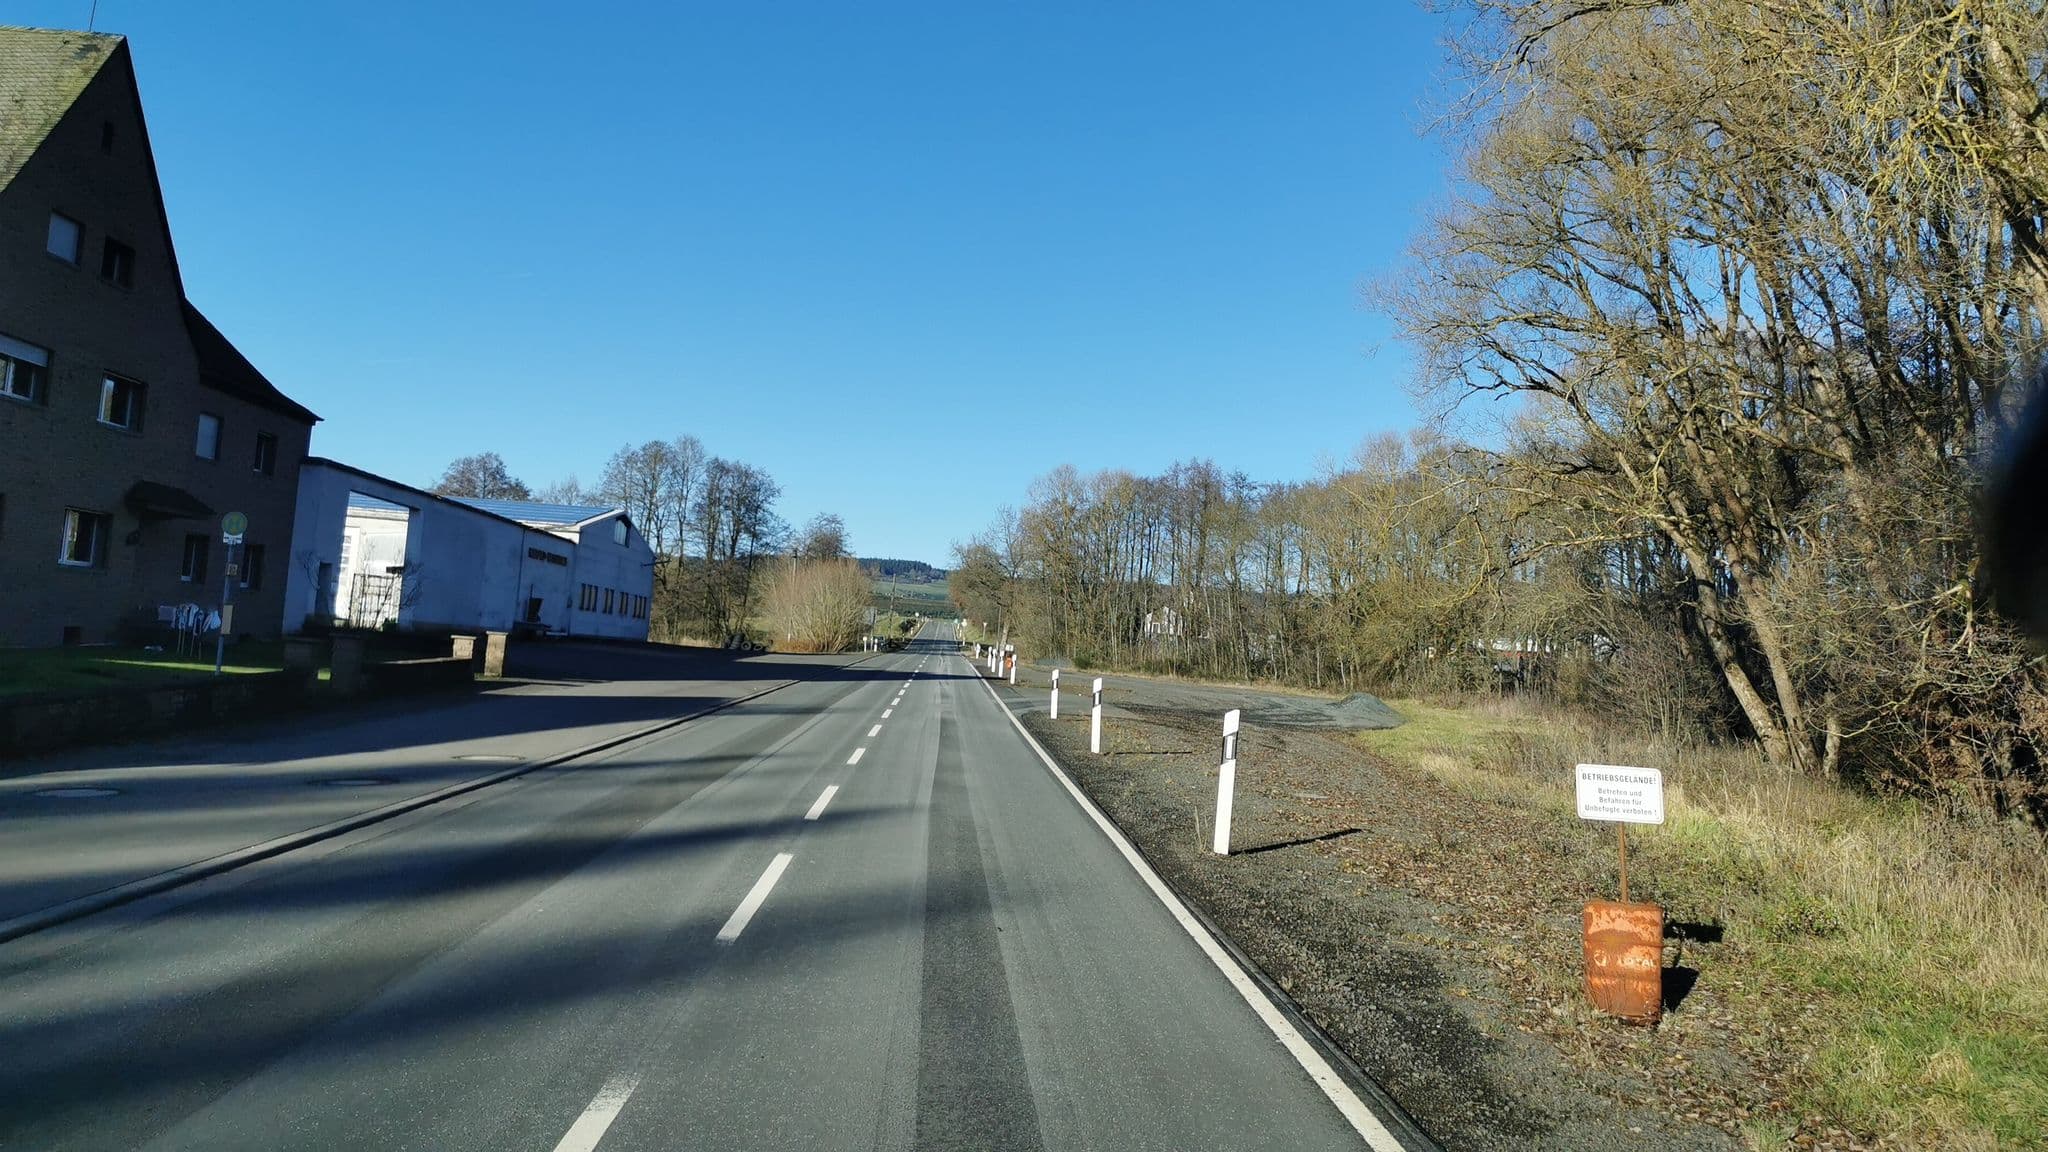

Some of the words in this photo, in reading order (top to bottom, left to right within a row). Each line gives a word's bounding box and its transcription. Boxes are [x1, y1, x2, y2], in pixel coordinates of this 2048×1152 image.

[1598, 787, 1628, 796] Betreten
[1599, 796, 1630, 805] Befahren
[1585, 804, 1620, 814] Unbefugte
